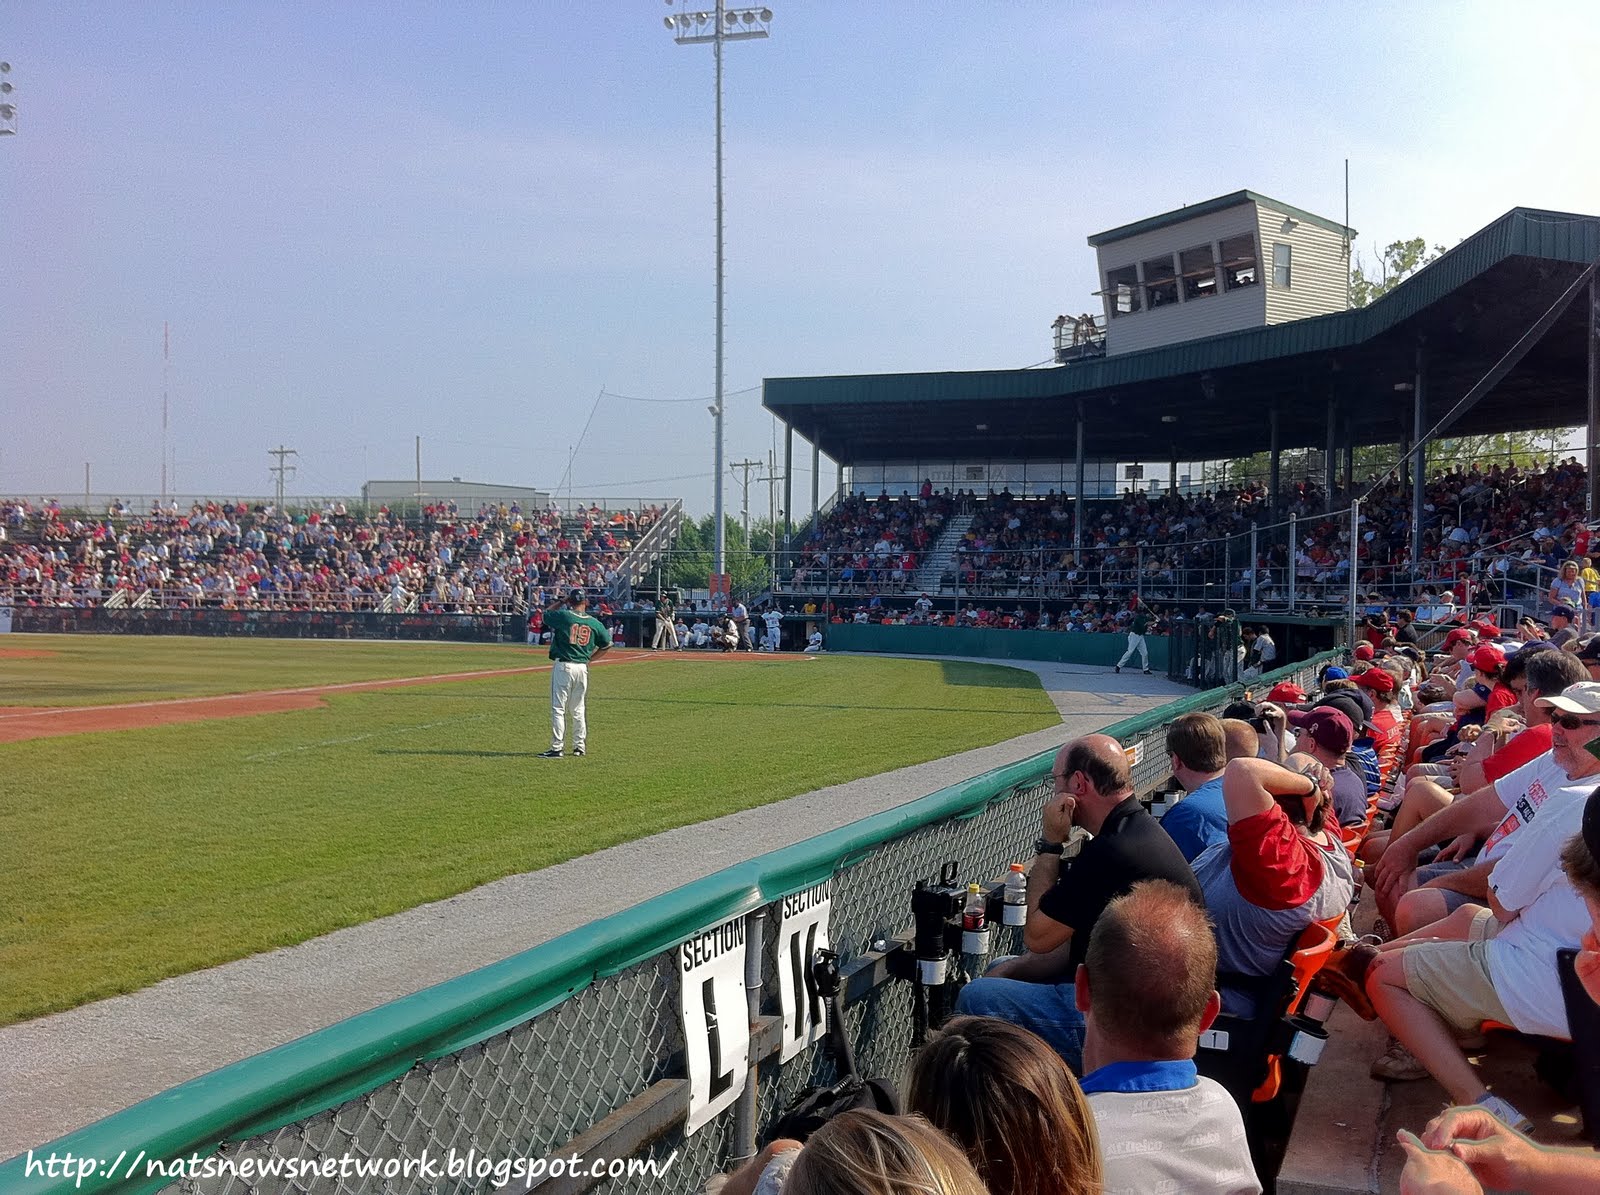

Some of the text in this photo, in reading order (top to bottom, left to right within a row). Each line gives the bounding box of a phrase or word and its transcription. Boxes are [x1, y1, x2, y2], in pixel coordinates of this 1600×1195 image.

[569, 623, 592, 647] 19
[783, 880, 830, 920] SECTION
[683, 915, 744, 972] SECTION
[702, 976, 735, 1105] L
[1211, 1031, 1217, 1048] 1
